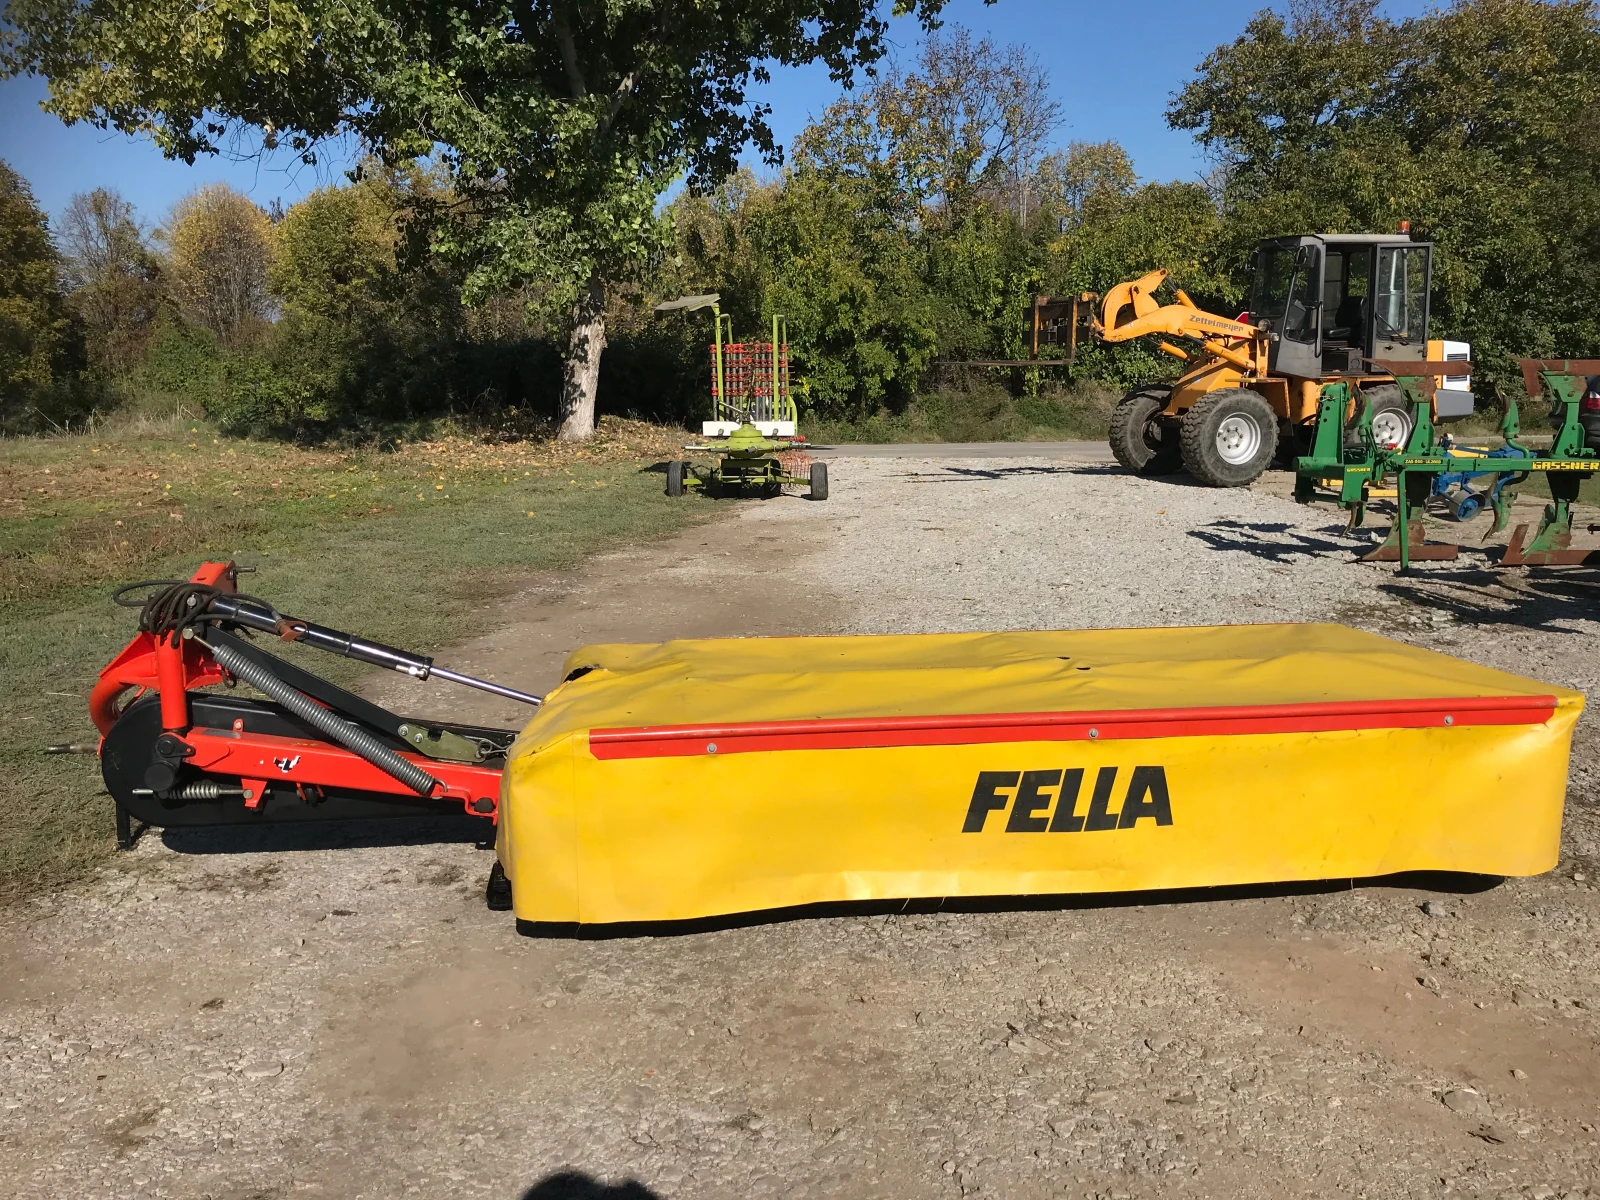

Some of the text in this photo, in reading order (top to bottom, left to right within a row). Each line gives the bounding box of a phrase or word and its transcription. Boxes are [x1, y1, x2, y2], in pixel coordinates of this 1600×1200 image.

[1189, 314, 1244, 332] Zettelmeyer
[1532, 461, 1600, 470] GASSNER
[961, 765, 1174, 833] FELLA
